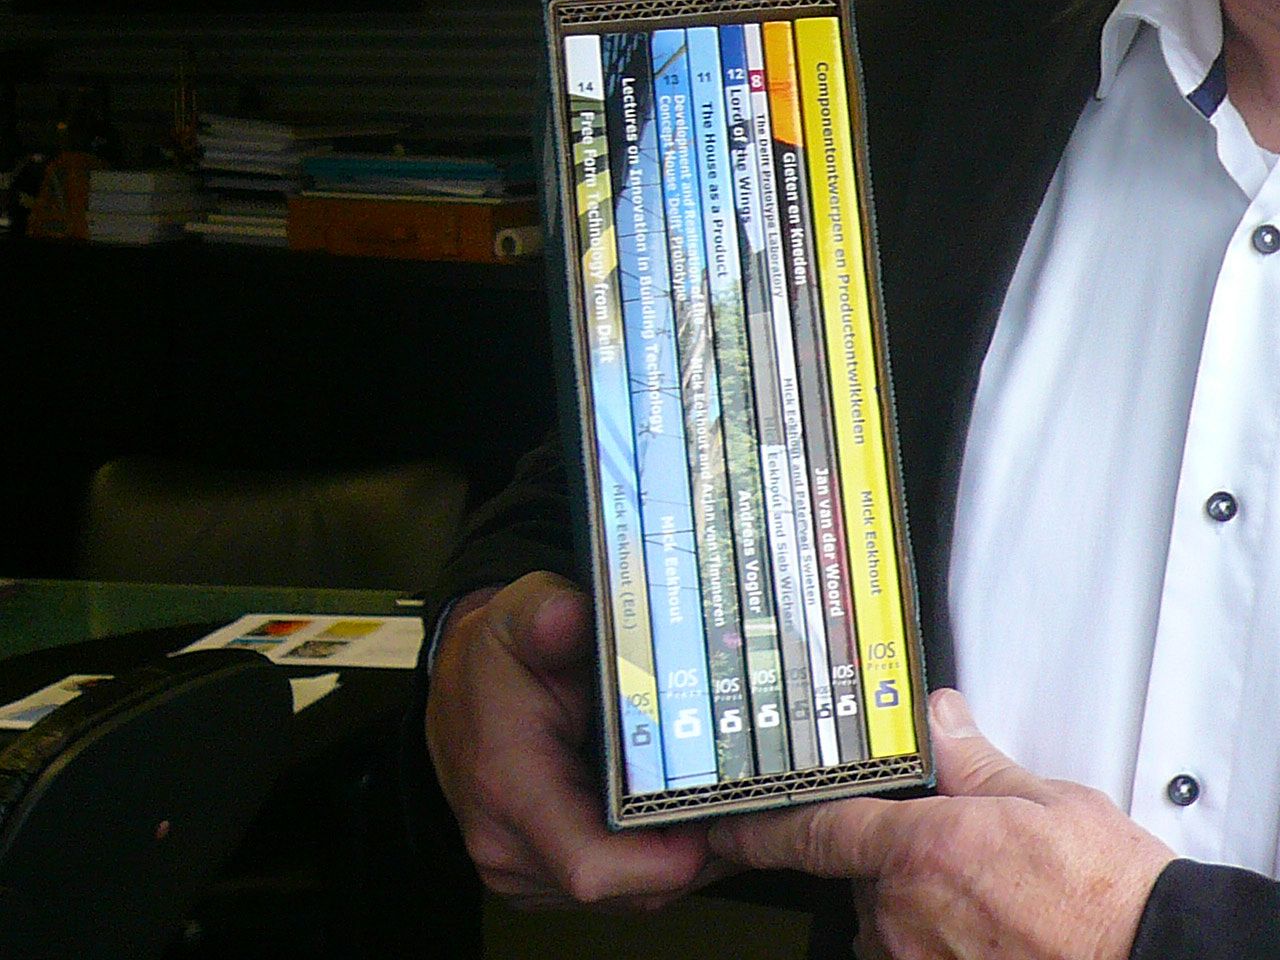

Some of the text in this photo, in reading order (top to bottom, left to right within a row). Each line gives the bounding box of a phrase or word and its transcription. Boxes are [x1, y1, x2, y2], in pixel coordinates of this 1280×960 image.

[577, 81, 594, 93] 14
[663, 74, 680, 86] 13
[696, 72, 712, 83] 11
[727, 69, 744, 80] 12
[751, 74, 762, 87] 8
[658, 95, 674, 149] Concept
[673, 94, 692, 179] Development
[664, 151, 679, 190] House
[729, 88, 752, 223] Lord of the Wings
[682, 181, 695, 206] and
[701, 101, 729, 278] The House as a Product
[756, 113, 782, 297] The Delft Prototype Laboratory
[579, 111, 614, 363] Free Form Technology from Delft
[782, 151, 808, 285] Gieten en Kneden
[622, 77, 664, 434] Lectures on Innovation in Building Technology
[670, 236, 688, 301] Prototype
[684, 209, 701, 282] Realisation
[816, 61, 864, 445] Componentontwerpen en Productontwikkelen
[691, 285, 704, 301] of
[782, 377, 794, 405] Mick
[693, 392, 709, 449] Eekhout
[786, 409, 801, 459] Eekhout
[699, 452, 712, 479] and
[766, 452, 783, 507] Eekhout
[792, 463, 804, 486] and
[611, 484, 626, 518] Mick
[772, 511, 785, 538] and
[795, 490, 808, 524] Peter
[615, 523, 632, 586] Eekhout
[737, 489, 763, 614] Andreas Vogler
[814, 466, 844, 617] Jan van der Woord
[859, 490, 882, 595] Mick Eekhout
[660, 514, 683, 624] Mick Eekhout
[708, 554, 723, 627] Timmeren
[802, 554, 817, 605] Swieten
[832, 664, 854, 679] IOS
[868, 641, 896, 660] IOS
[668, 668, 699, 689] IOS
[716, 677, 740, 693] IOS
[752, 669, 776, 685] IOS
